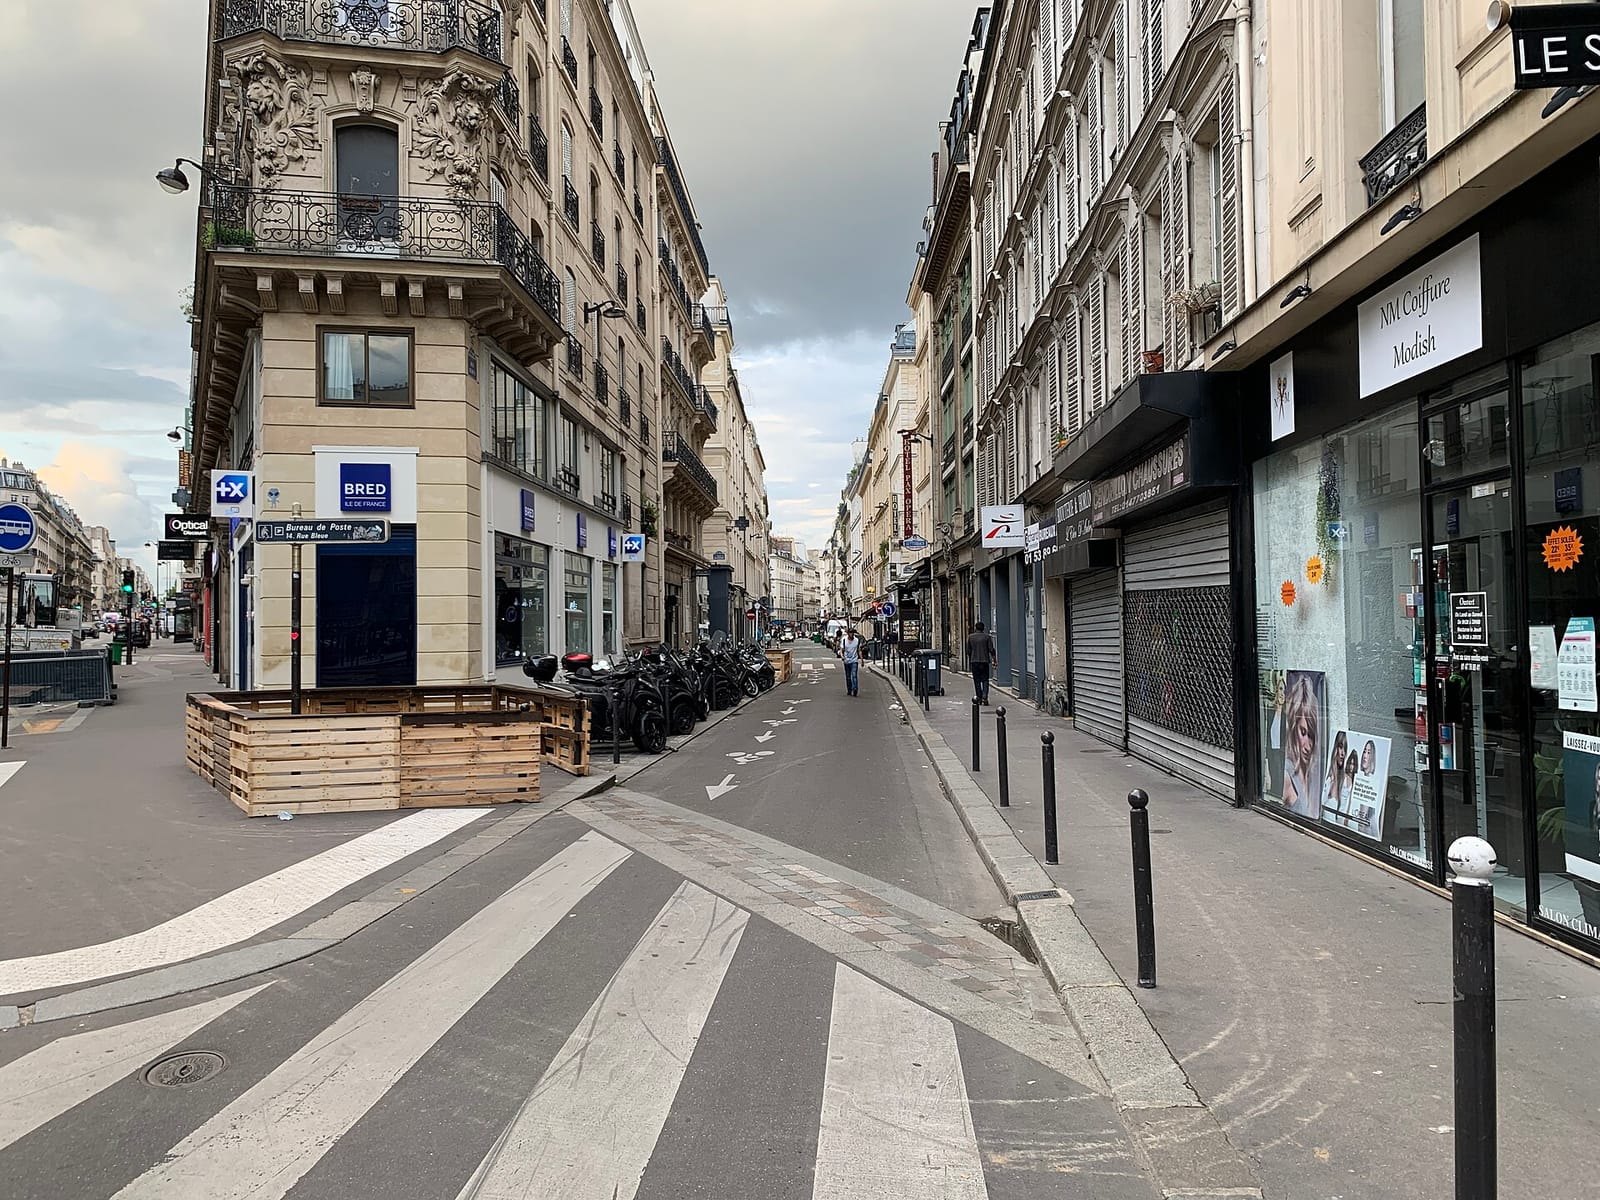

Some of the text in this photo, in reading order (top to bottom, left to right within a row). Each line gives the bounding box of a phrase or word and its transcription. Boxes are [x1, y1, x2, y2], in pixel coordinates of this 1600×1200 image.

[1518, 36, 1569, 75] LE
[1380, 275, 1451, 329] NM Coiffure
[1393, 325, 1436, 369] Modish
[1132, 438, 1184, 491] CHAUSSURES
[344, 483, 387, 495] BRED
[172, 519, 209, 532] Optical
[286, 523, 352, 531] Bureau de Poste
[1024, 553, 1032, 565] 01
[1033, 549, 1042, 562] 53
[1538, 904, 1569, 927] SALON
